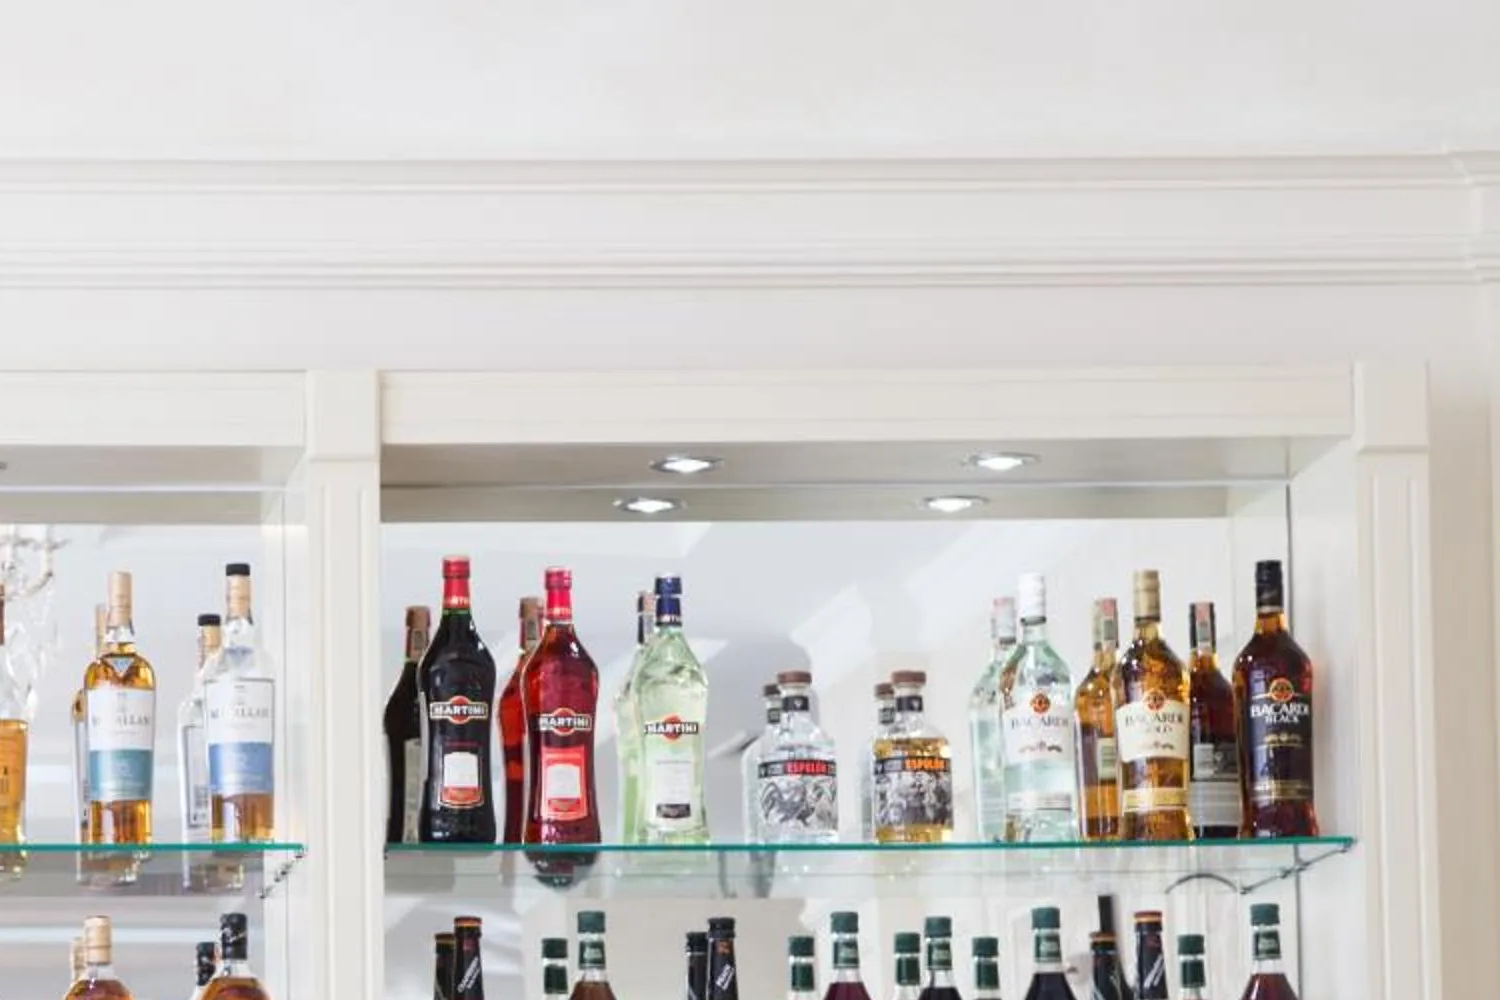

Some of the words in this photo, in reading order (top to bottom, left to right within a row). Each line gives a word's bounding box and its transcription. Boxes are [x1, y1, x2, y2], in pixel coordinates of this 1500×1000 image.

[433, 703, 485, 717] MARTINI
[1251, 703, 1310, 719] BACARDI
[540, 713, 589, 729] MARTINI
[1264, 714, 1299, 724] BLACK
[647, 720, 697, 734] MARTINI
